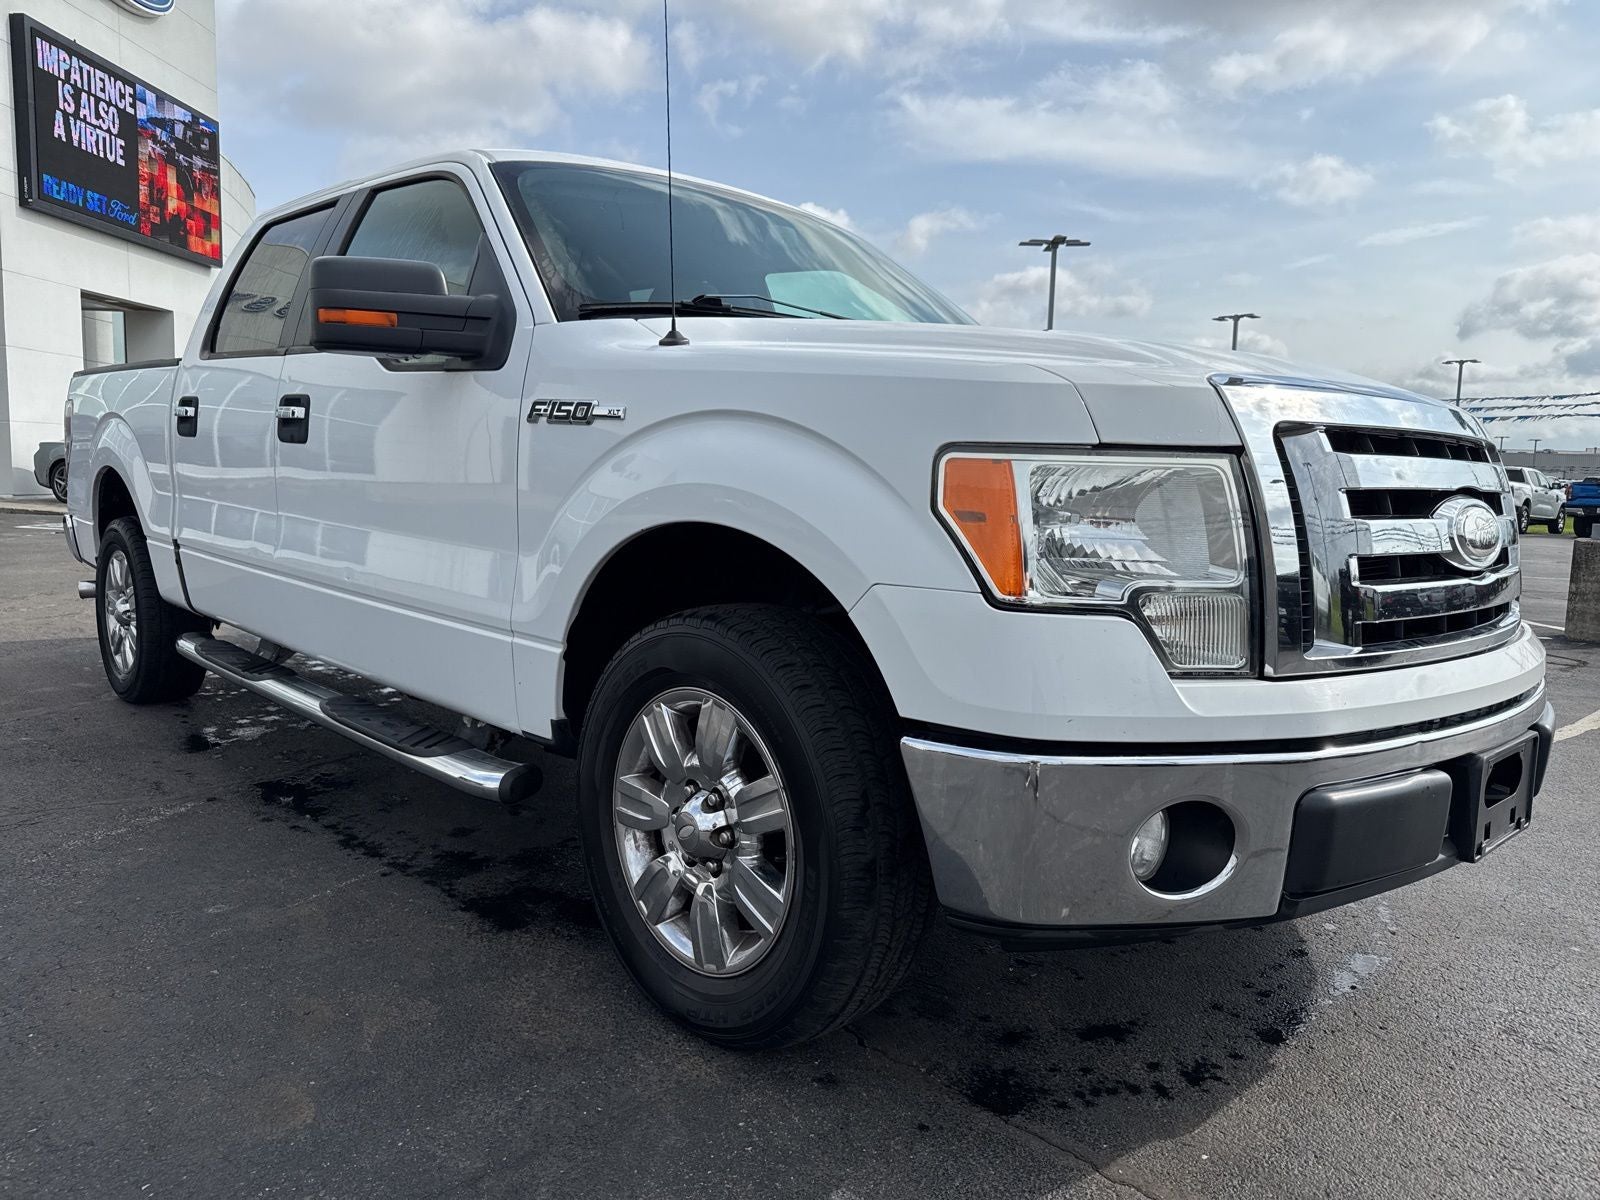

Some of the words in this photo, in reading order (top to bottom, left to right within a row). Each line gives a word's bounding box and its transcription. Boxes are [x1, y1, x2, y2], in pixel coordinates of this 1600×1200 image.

[35, 36, 135, 116] IMPATIENCE
[57, 80, 75, 115] IS
[79, 91, 120, 135] ALSO
[53, 109, 66, 143] A
[69, 117, 126, 167] VIRTUE
[42, 173, 85, 208] READY
[86, 189, 108, 216] SET
[108, 199, 139, 226] Ford
[527, 399, 594, 425] F-150
[607, 408, 621, 416] XLT
